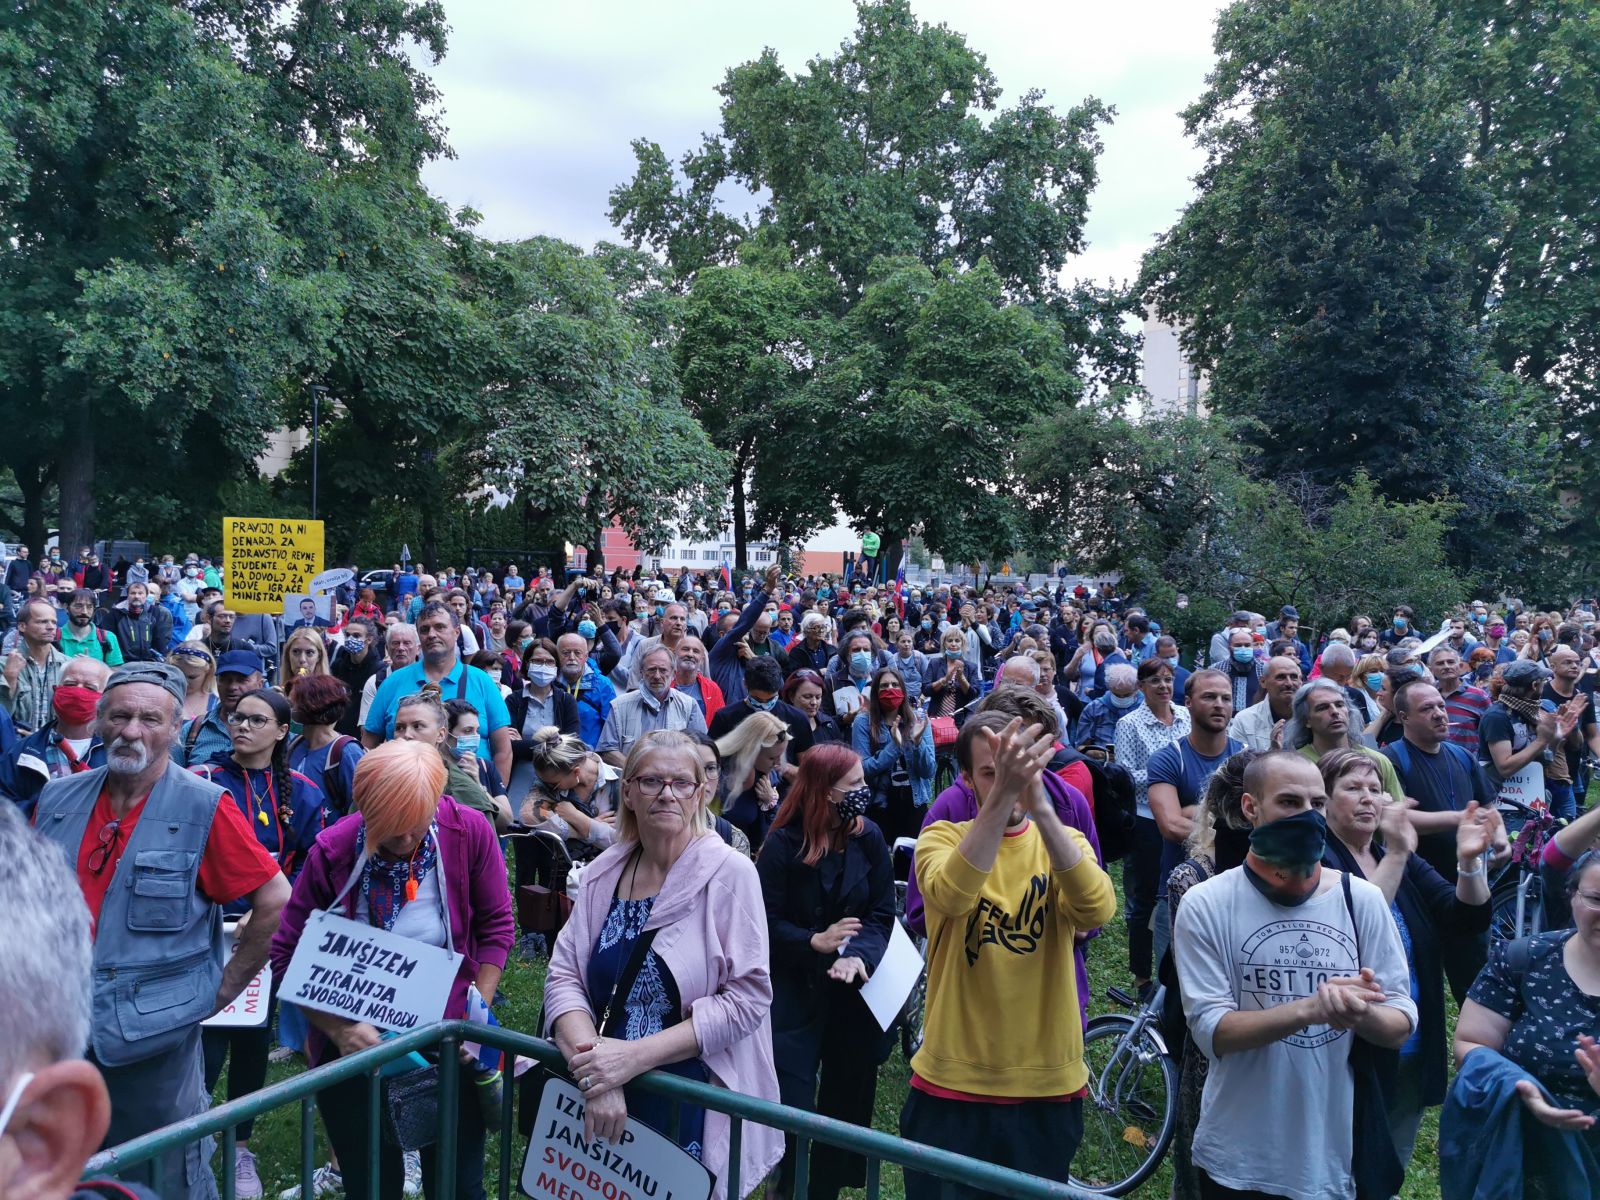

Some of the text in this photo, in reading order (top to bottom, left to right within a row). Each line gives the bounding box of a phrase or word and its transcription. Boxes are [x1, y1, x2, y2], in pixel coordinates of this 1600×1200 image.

[280, 523, 292, 534] DA
[297, 524, 307, 534] NI
[232, 536, 295, 547] DENARJA ZA
[232, 549, 315, 562] ZDRAVSTVO, REVNE
[287, 562, 298, 571] GA
[304, 563, 315, 574] JE
[232, 570, 303, 584] PA DOVOLJ ZA
[232, 581, 302, 593] NOVE IGRAČE
[232, 591, 283, 602] MINISTRA
[1256, 928, 1272, 940] TOM
[1276, 922, 1311, 930] TAILOR
[1316, 923, 1332, 935] REG
[318, 930, 418, 979] JANŠIZEM
[1279, 945, 1295, 954] 957
[1315, 948, 1330, 957] 872
[1274, 958, 1336, 968] MOUNTAIN
[309, 963, 396, 1004] TIRANIJA
[1254, 968, 1297, 991] EST
[295, 983, 419, 1028] SVOBODA NARODU
[1311, 1030, 1338, 1046] CHOICE
[545, 1119, 659, 1197] JANŠIZMU
